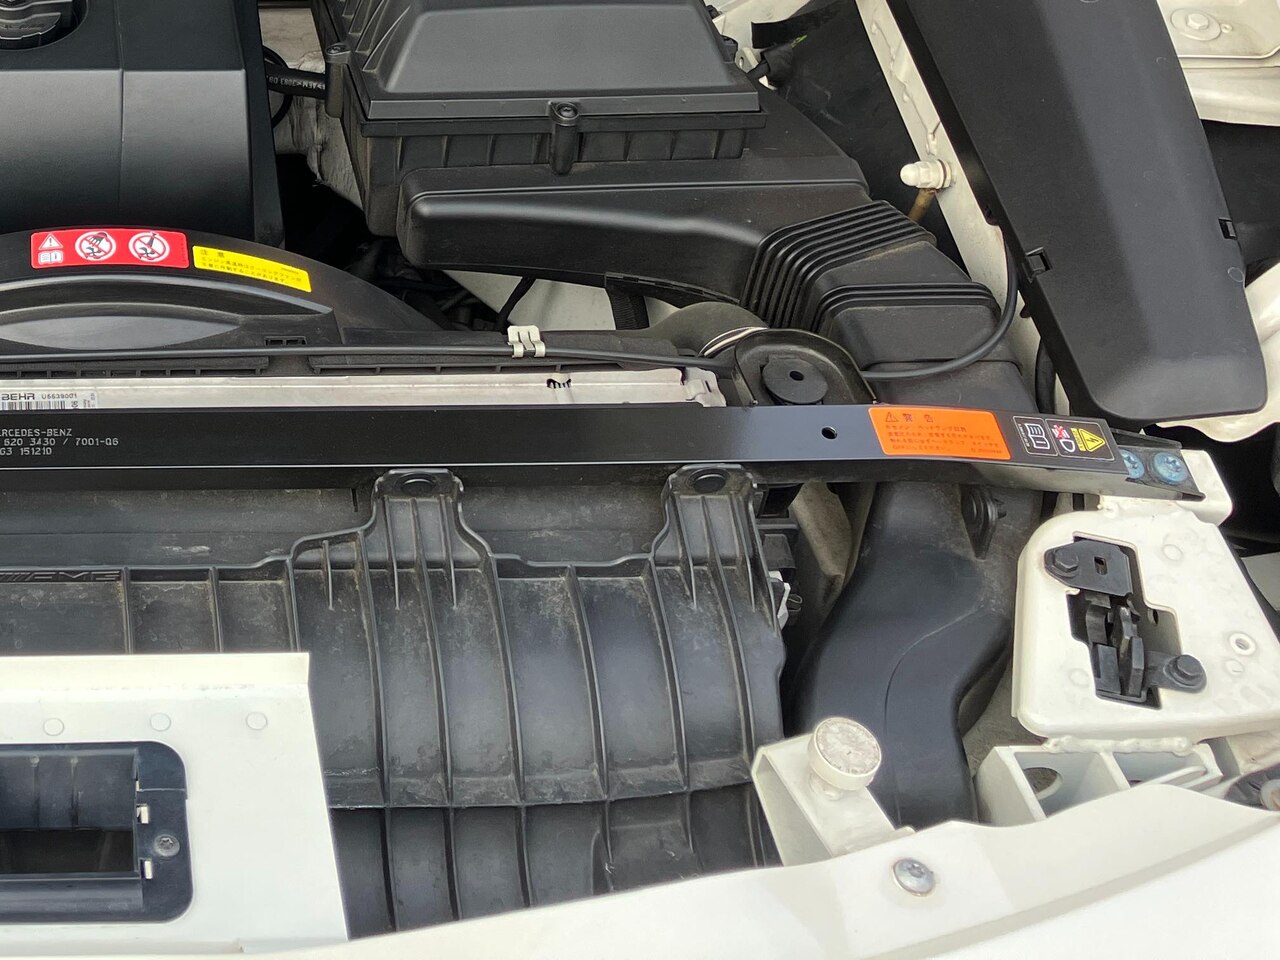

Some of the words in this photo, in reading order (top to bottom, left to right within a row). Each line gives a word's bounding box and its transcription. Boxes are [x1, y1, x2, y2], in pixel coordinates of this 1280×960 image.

[1, 392, 35, 401] BEHR
[3, 438, 24, 447] 620
[29, 438, 56, 446] 3430
[62, 438, 69, 446] /
[19, 447, 53, 456] 151210
